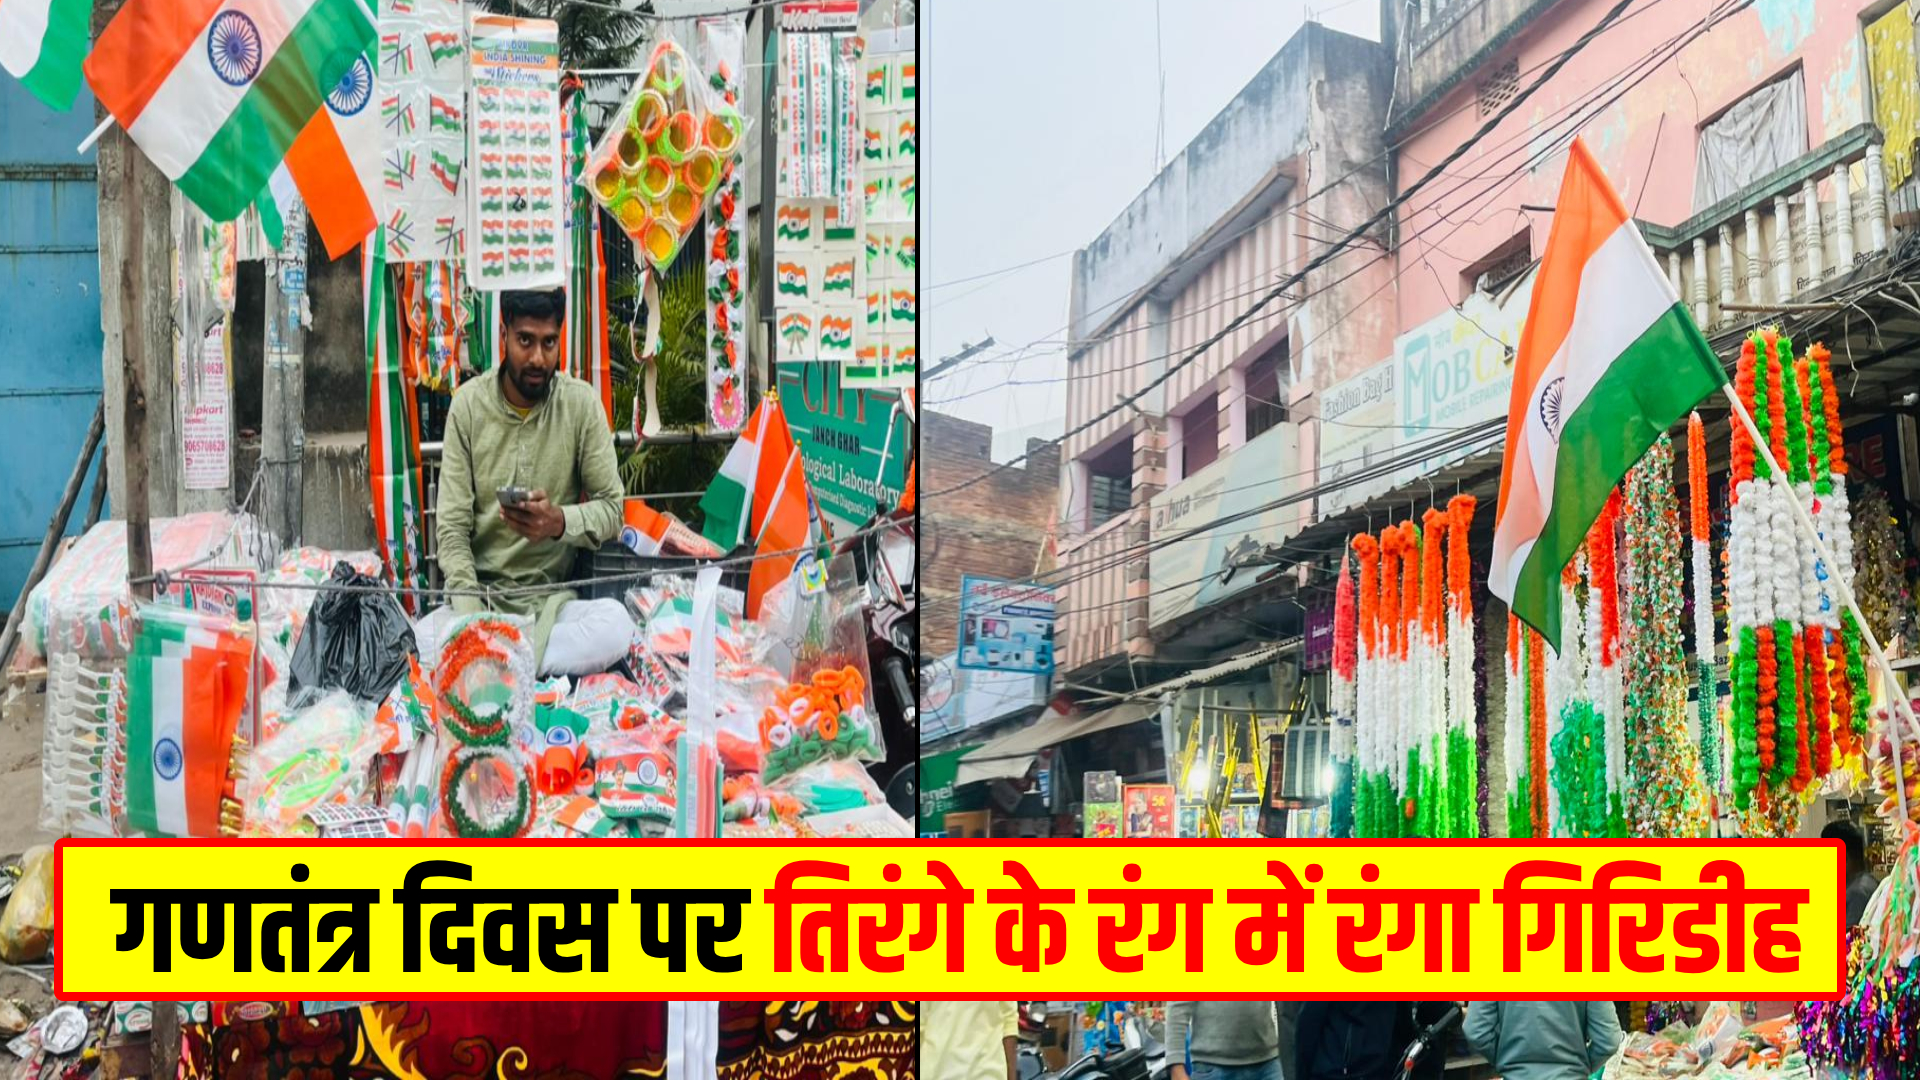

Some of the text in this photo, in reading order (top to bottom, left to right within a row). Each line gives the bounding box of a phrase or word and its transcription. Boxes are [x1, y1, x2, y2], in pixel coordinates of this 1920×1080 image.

[483, 51, 547, 65] INDIA SHINING
[1324, 386, 1361, 421] Fashion
[1361, 376, 1383, 404] Bag
[812, 424, 860, 457] JANCH GHAR
[839, 463, 900, 512] Laboratory
